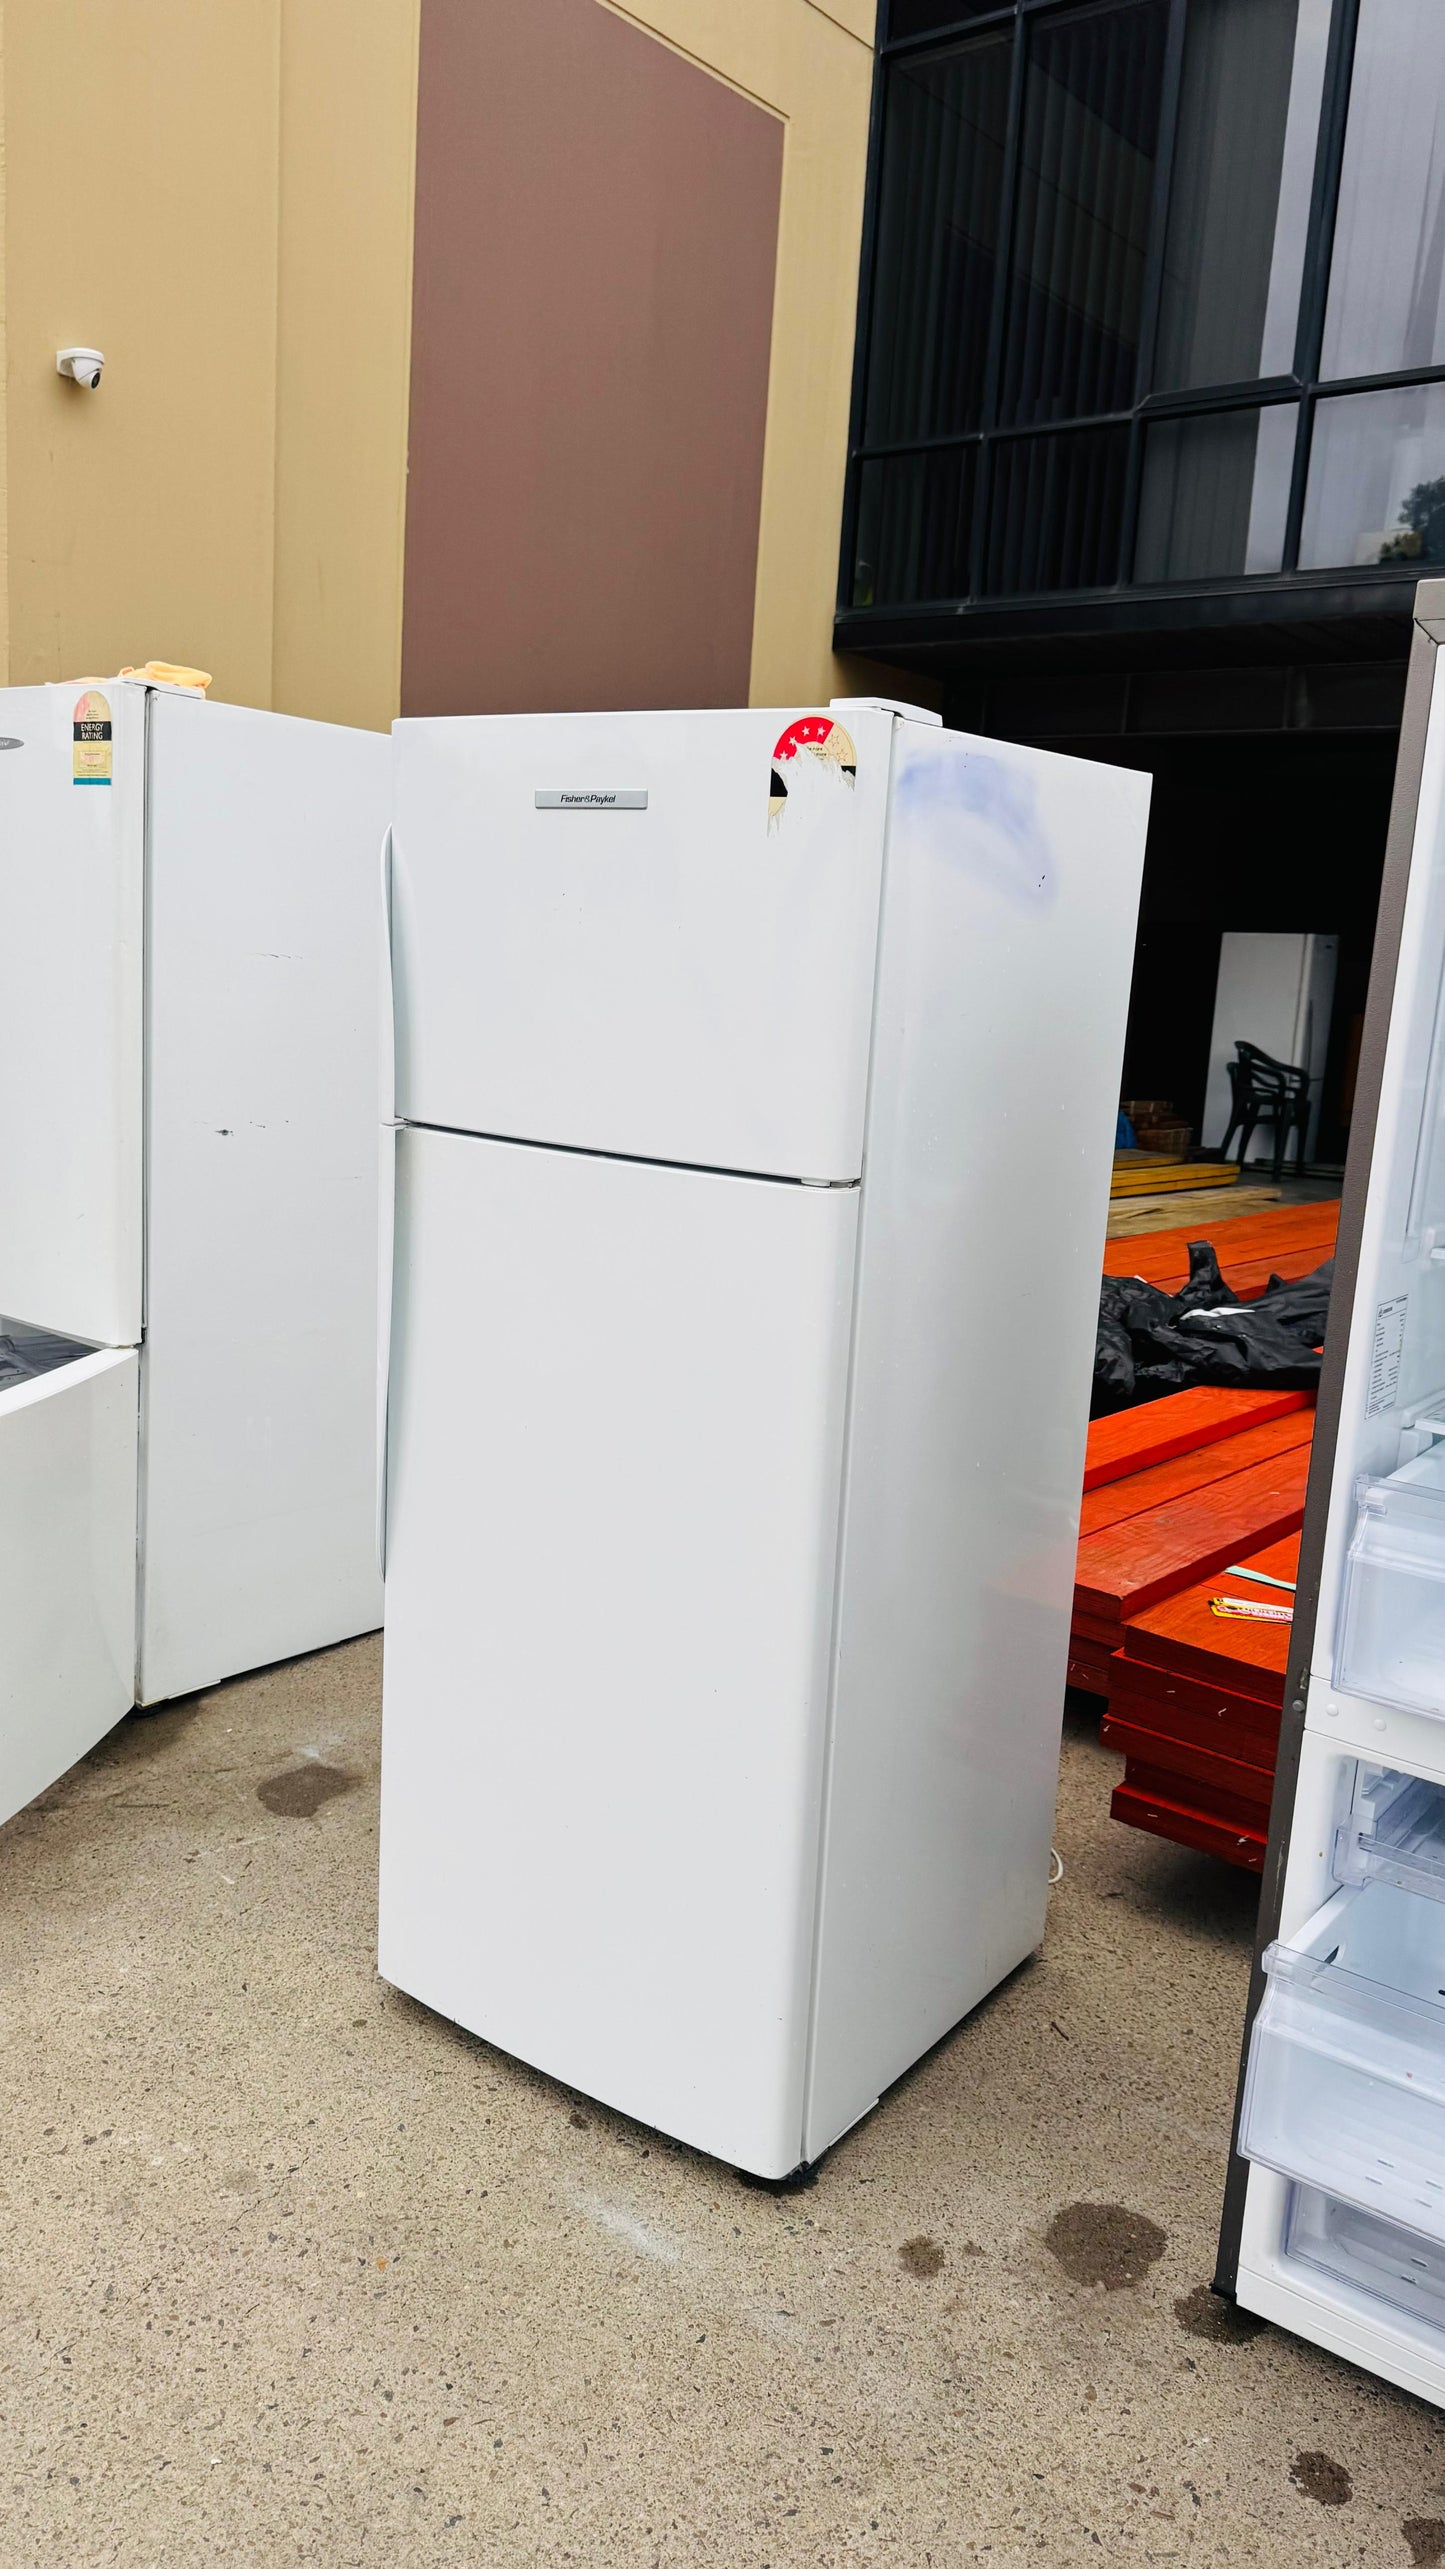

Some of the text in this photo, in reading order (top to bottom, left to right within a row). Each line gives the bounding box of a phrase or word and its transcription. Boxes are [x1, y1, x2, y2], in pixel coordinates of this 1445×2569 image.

[81, 724, 104, 732] ENERGY
[82, 732, 103, 740] RATING
[561, 794, 616, 805] Fisher&Paykel
